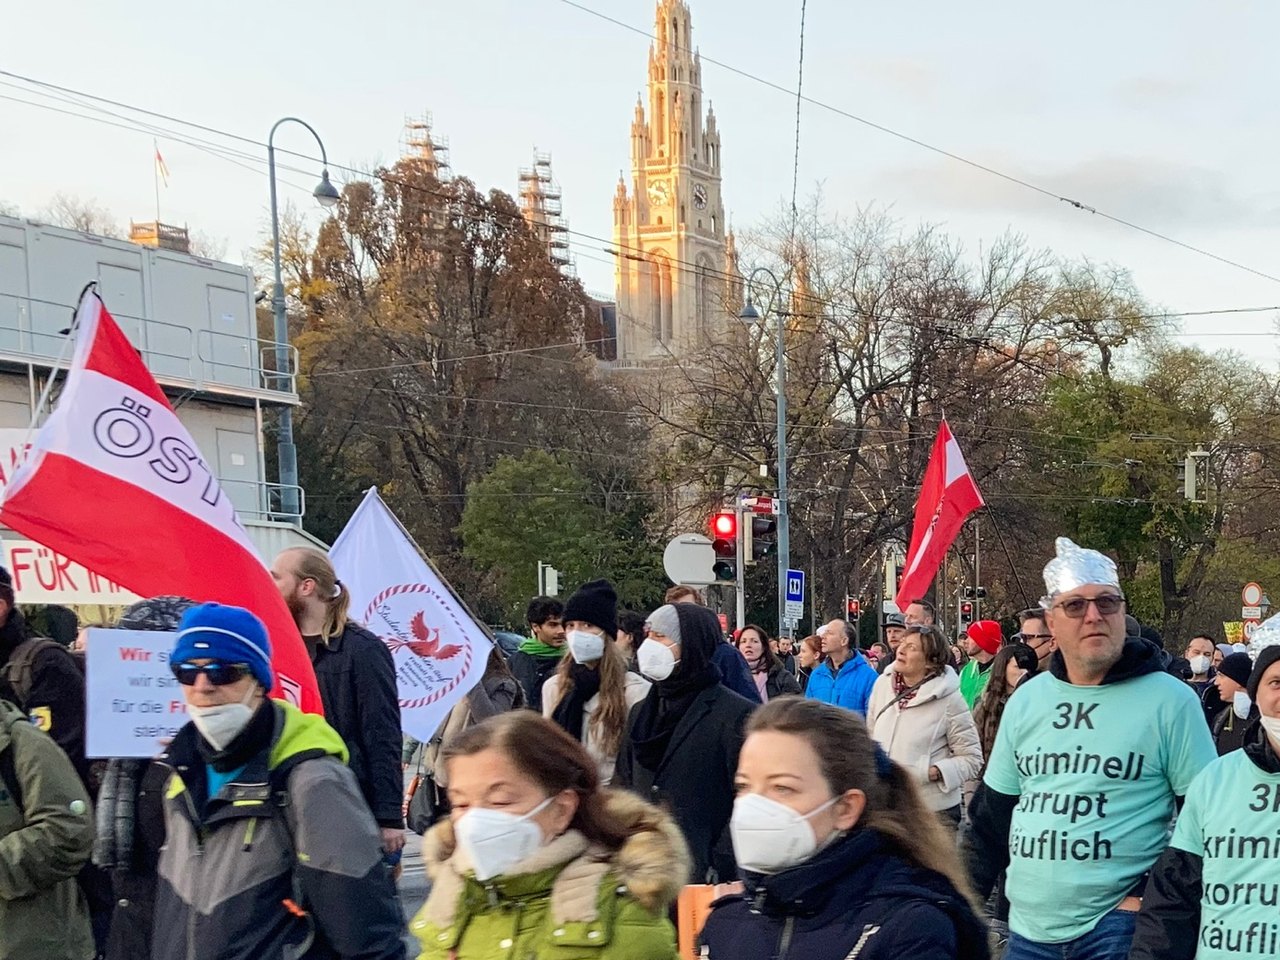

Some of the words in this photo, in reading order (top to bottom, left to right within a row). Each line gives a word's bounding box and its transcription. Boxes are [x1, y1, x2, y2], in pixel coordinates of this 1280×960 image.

[94, 396, 243, 532] ÖST
[119, 646, 152, 662] Wir
[128, 673, 152, 687] wir
[157, 673, 180, 688] sin
[112, 698, 135, 713] für
[138, 699, 163, 714] die
[1052, 701, 1100, 730] 3K
[134, 724, 178, 738] stehe
